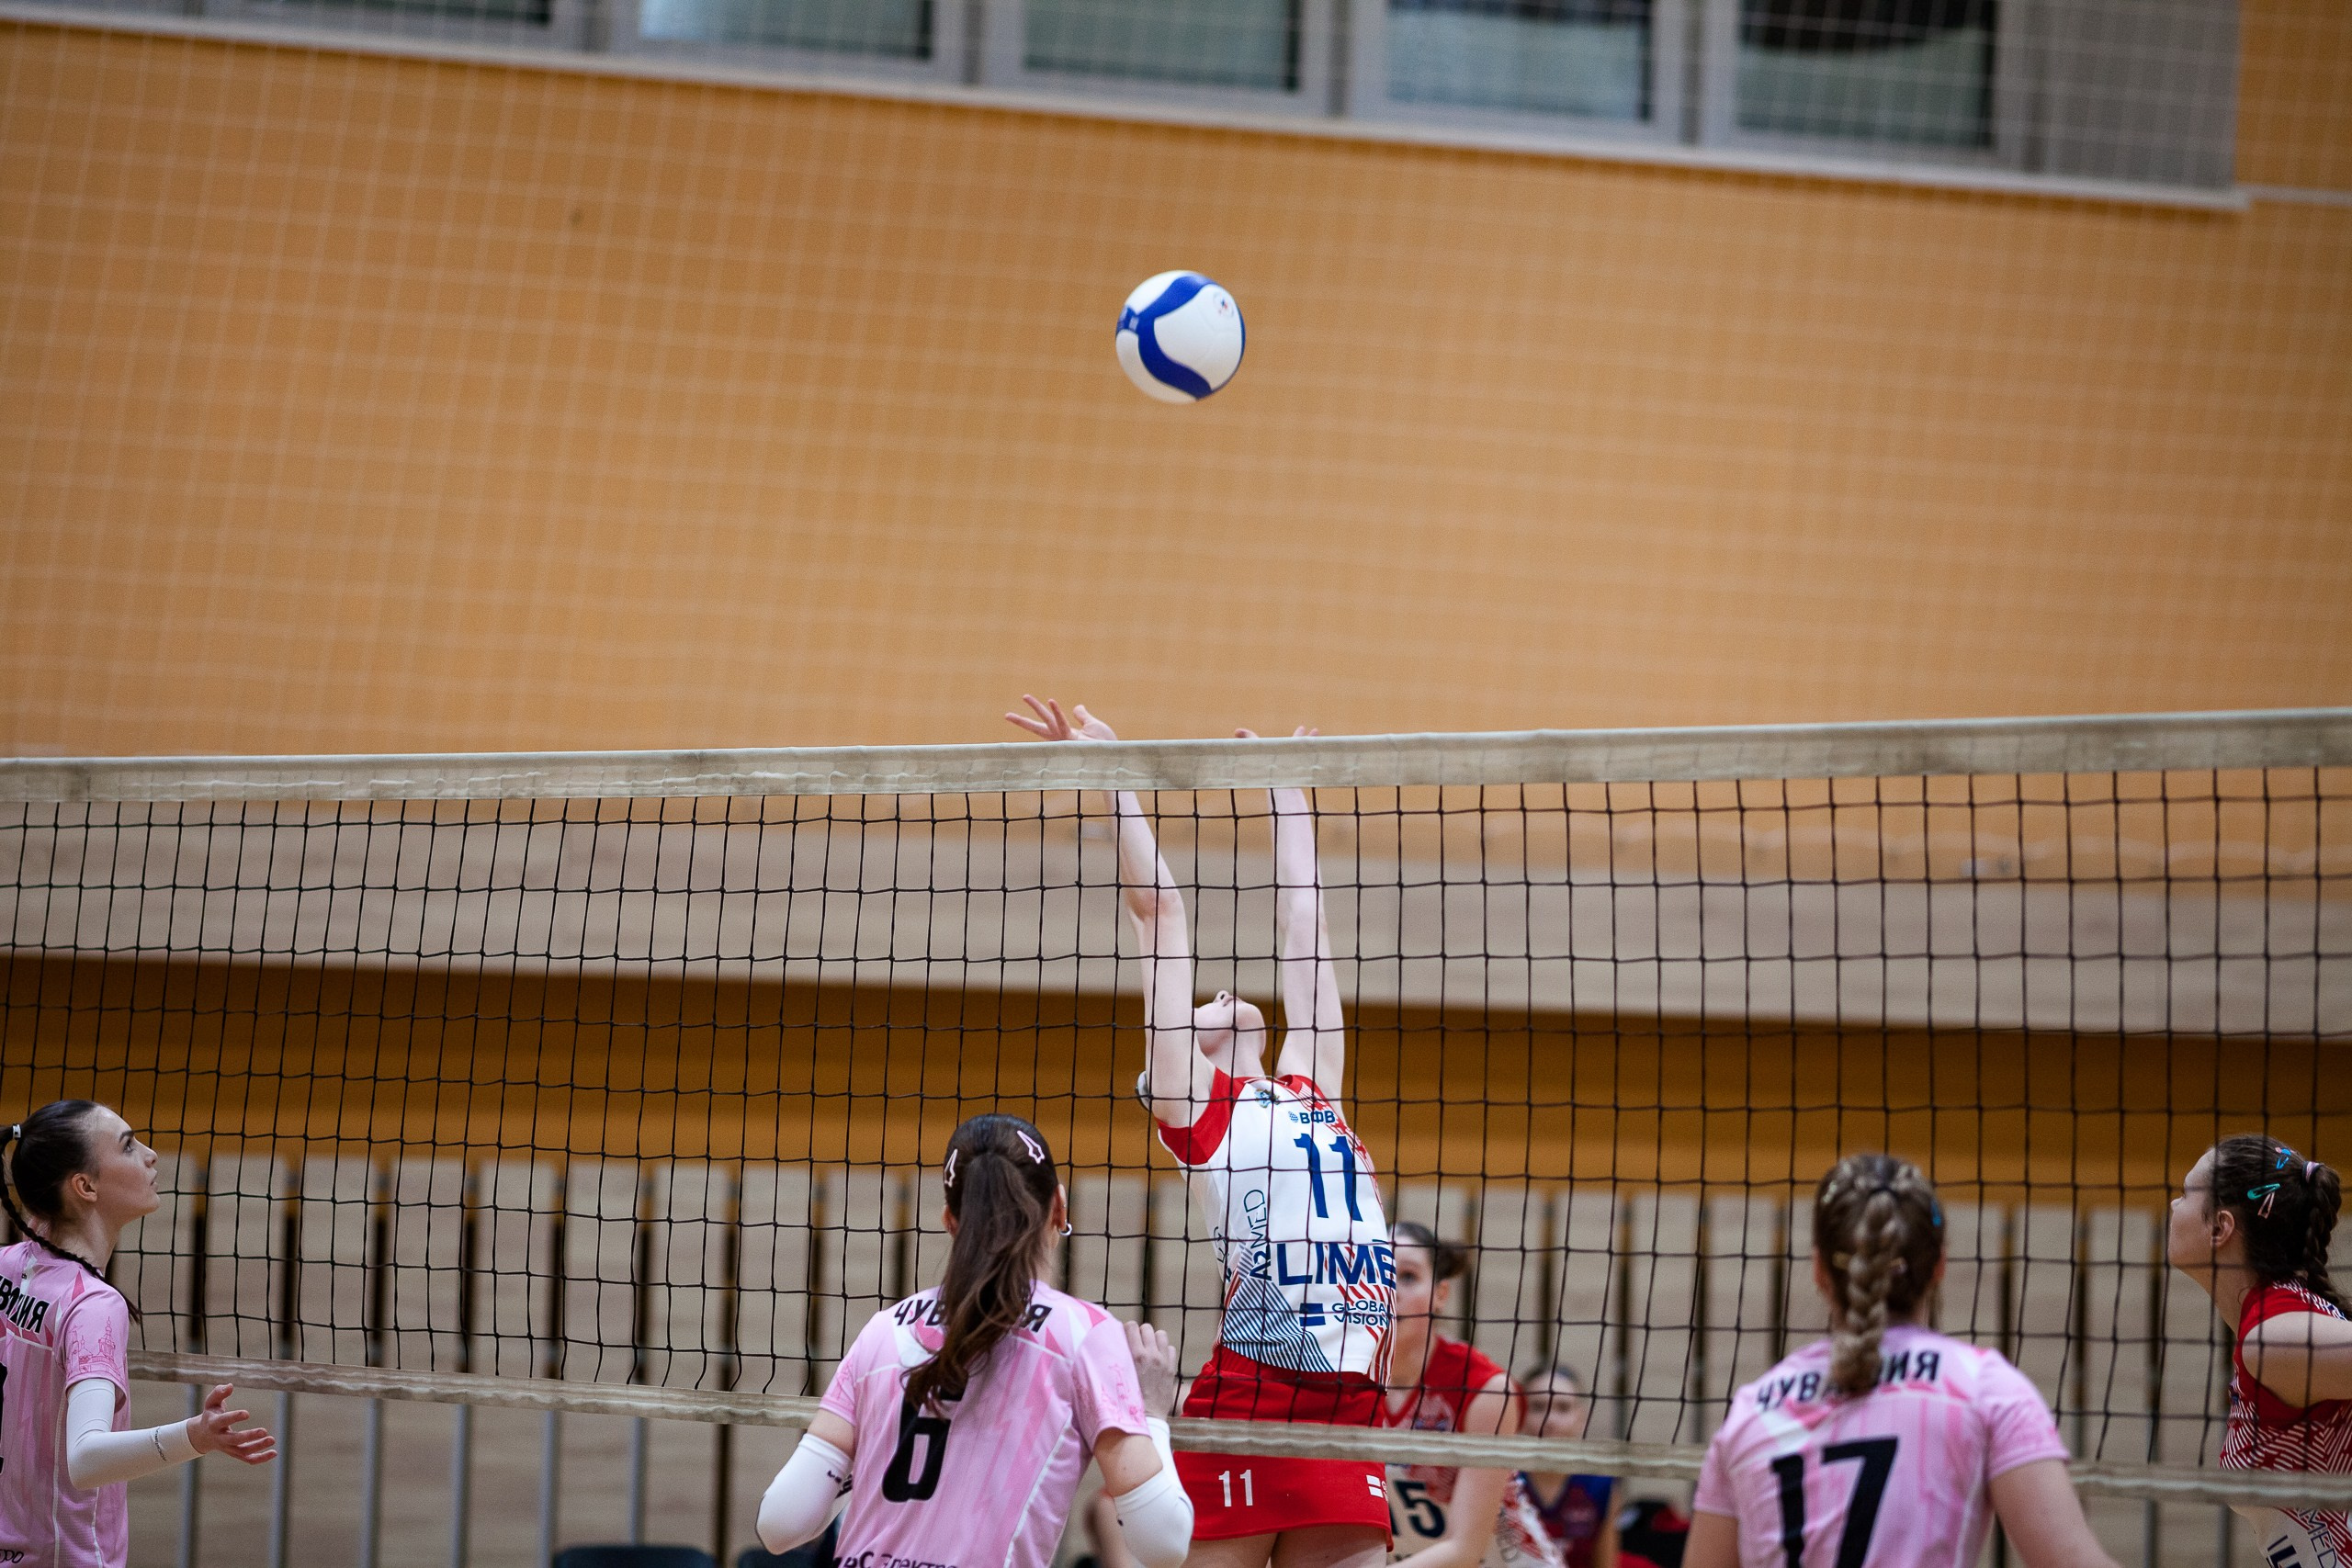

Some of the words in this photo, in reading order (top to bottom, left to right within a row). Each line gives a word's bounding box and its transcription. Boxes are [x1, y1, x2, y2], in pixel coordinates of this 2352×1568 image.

[1300, 1111, 1337, 1124] ВФВ
[1294, 1133, 1363, 1222] 11
[894, 1299, 1053, 1333] ЧУВЯ
[1334, 1312, 1389, 1328] VISION
[1757, 1349, 1940, 1412] ЧУВИЯ
[882, 1373, 969, 1503] 6
[1218, 1469, 1254, 1507] 11
[1770, 1435, 1899, 1568] 17
[2298, 1506, 2337, 1568] MED
